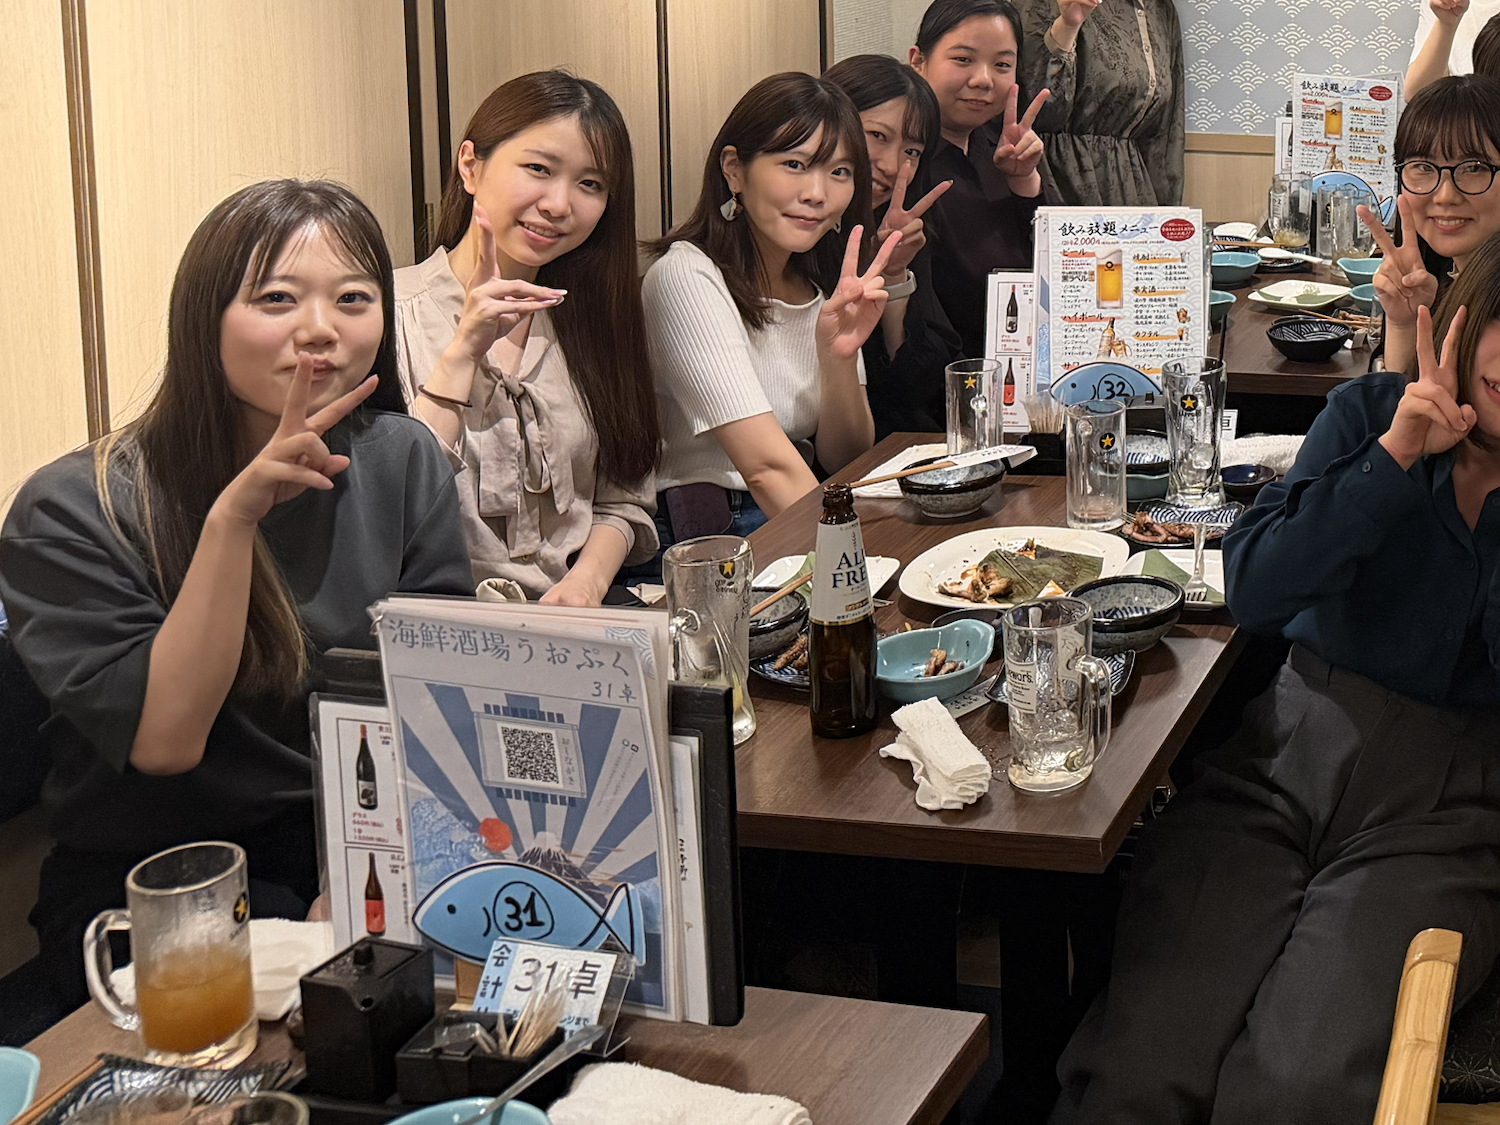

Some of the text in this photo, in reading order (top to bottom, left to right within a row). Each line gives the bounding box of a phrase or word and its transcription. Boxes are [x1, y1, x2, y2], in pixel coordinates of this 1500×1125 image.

[1058, 221, 1159, 236] 飲み放題メニュー
[1061, 275, 1088, 283] 黒ラベル
[1062, 312, 1105, 321] ハイボール
[1103, 380, 1130, 400] 32
[388, 618, 630, 677] 海鮮酒場うおぷく
[504, 891, 546, 932] 31
[477, 943, 512, 1013] 会計
[514, 957, 602, 1000] 31卓
